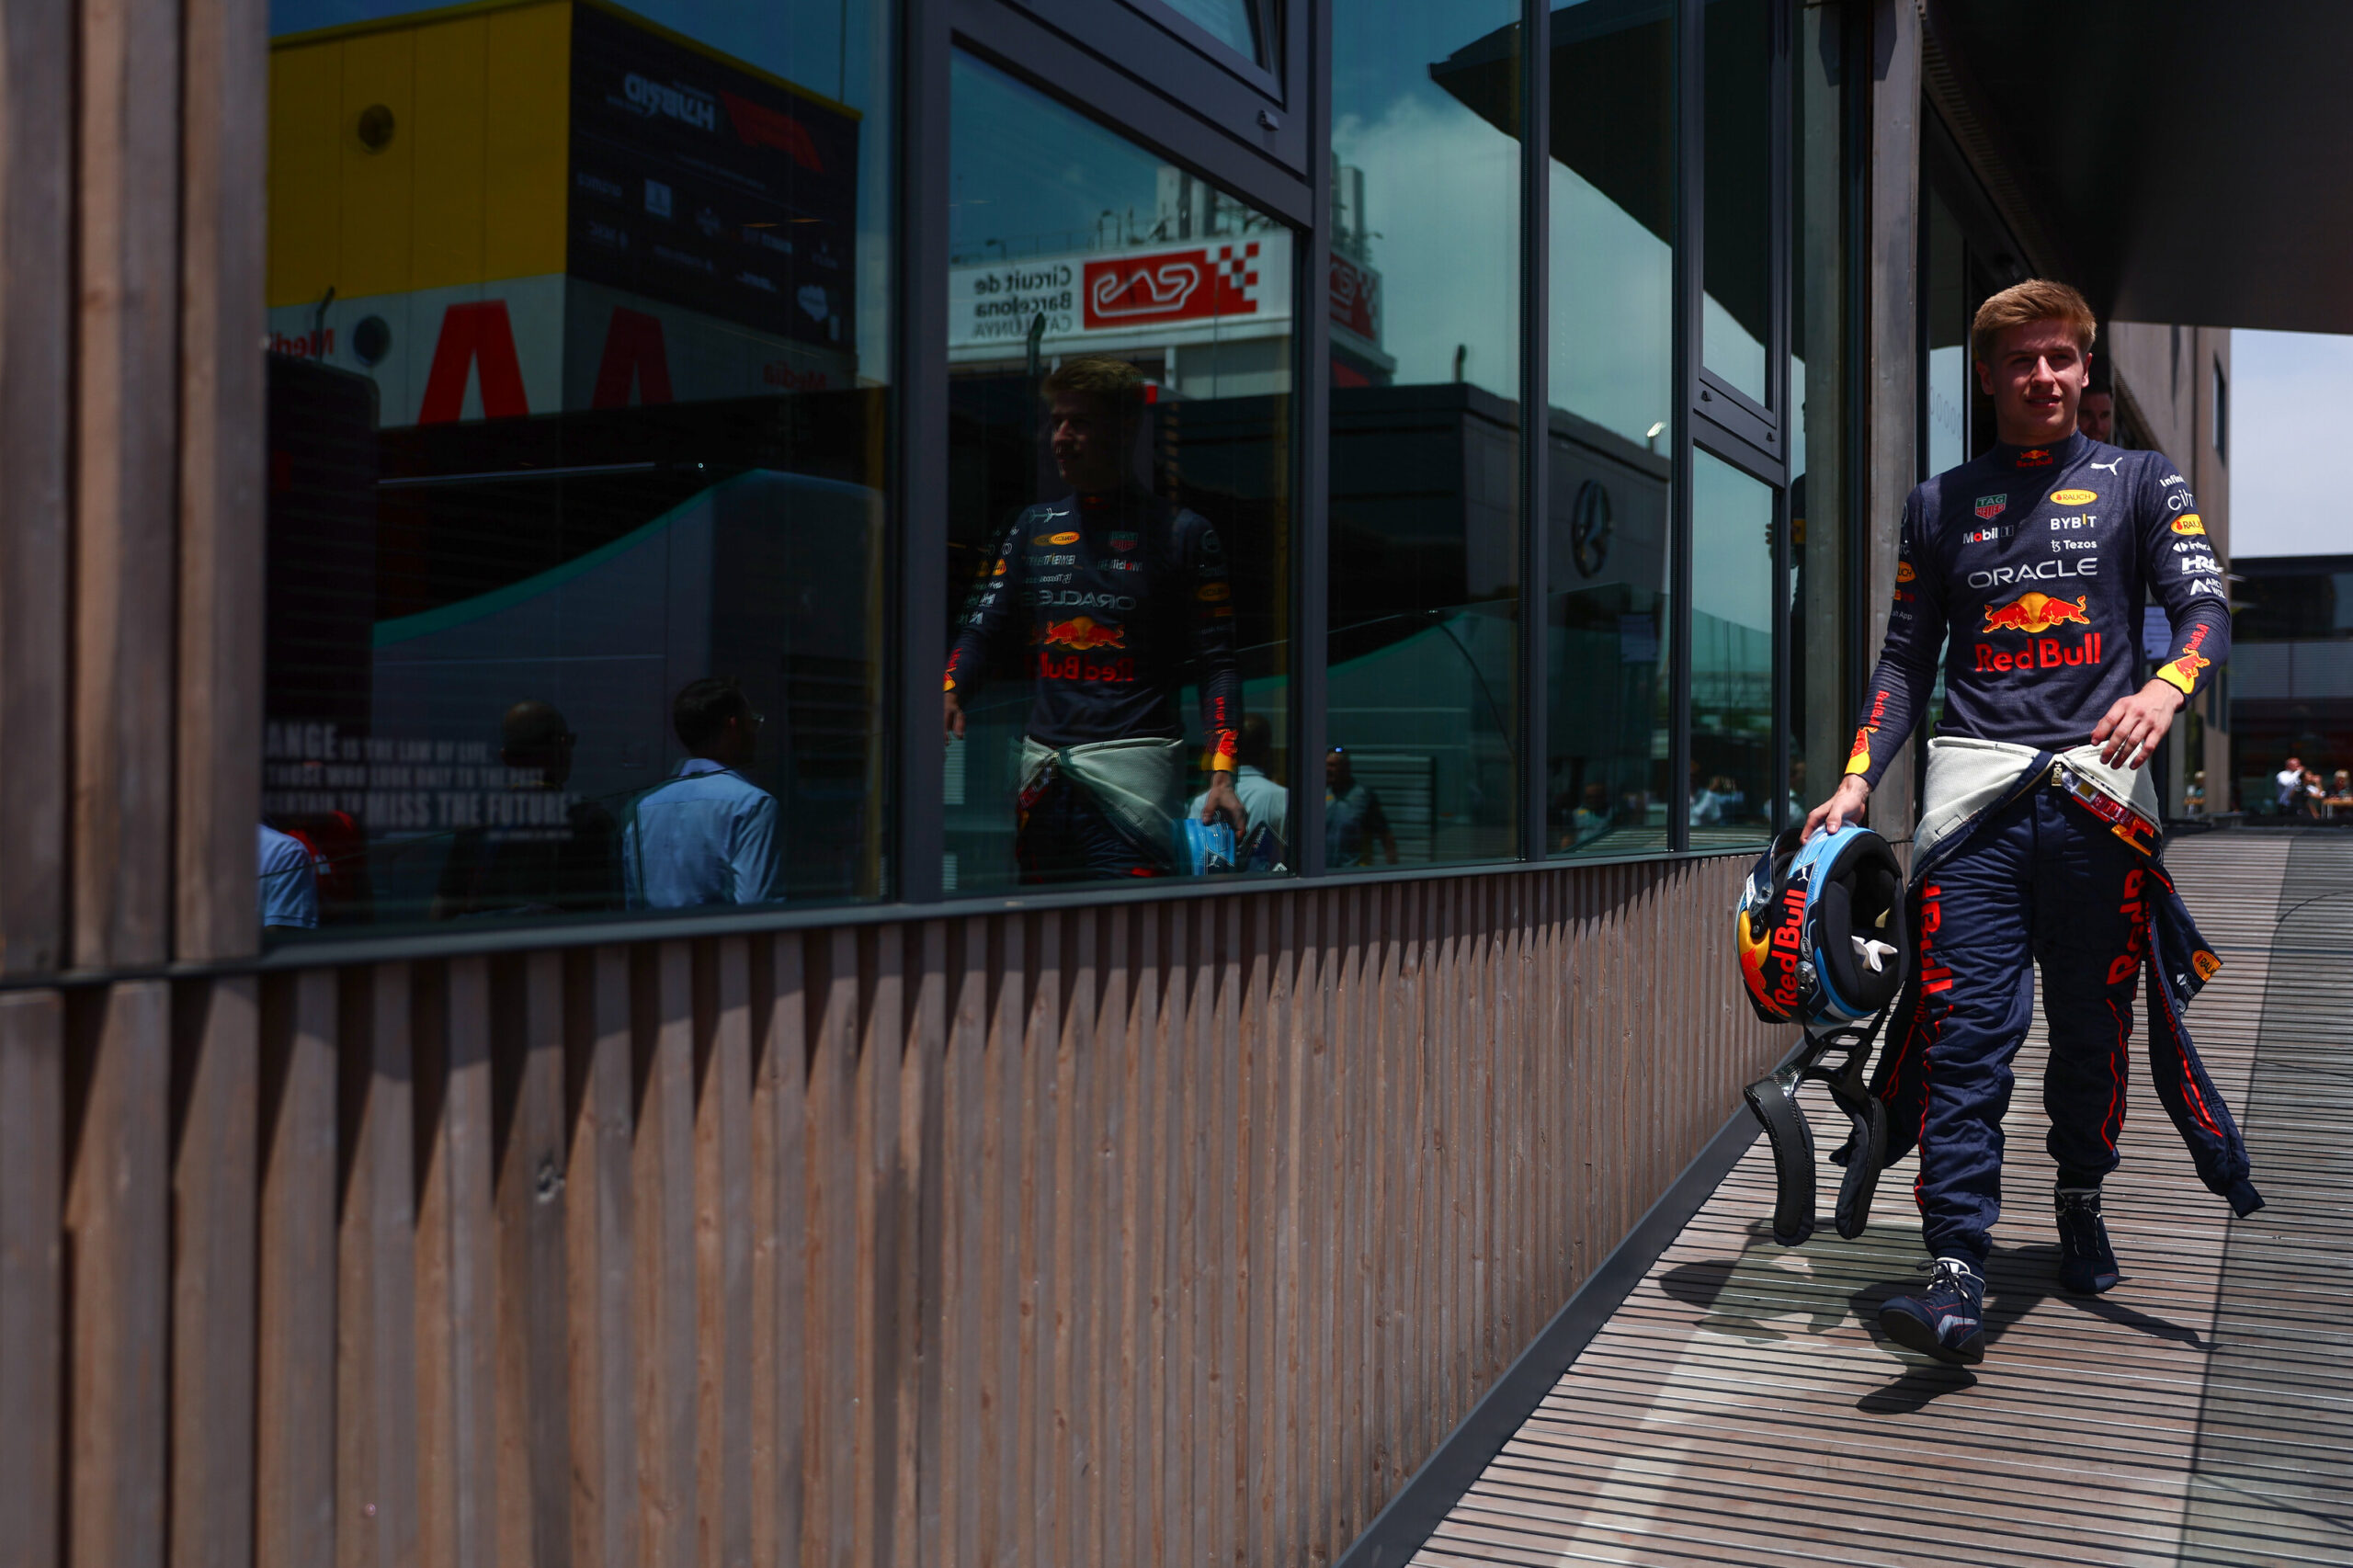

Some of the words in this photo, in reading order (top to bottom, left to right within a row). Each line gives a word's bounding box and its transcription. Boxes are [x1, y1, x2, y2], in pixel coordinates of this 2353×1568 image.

[1979, 495, 2004, 506] TAG
[1976, 506, 2005, 518] HEUER
[2051, 513, 2097, 530] BYBIT
[1963, 528, 1999, 544] Mobil
[2063, 540, 2097, 550] Tezos
[1967, 557, 2098, 589] ORACLE
[1974, 637, 2035, 672] Red
[2039, 631, 2101, 668] Bull
[1774, 889, 1807, 949] Bull
[1771, 950, 1799, 1006] Red
